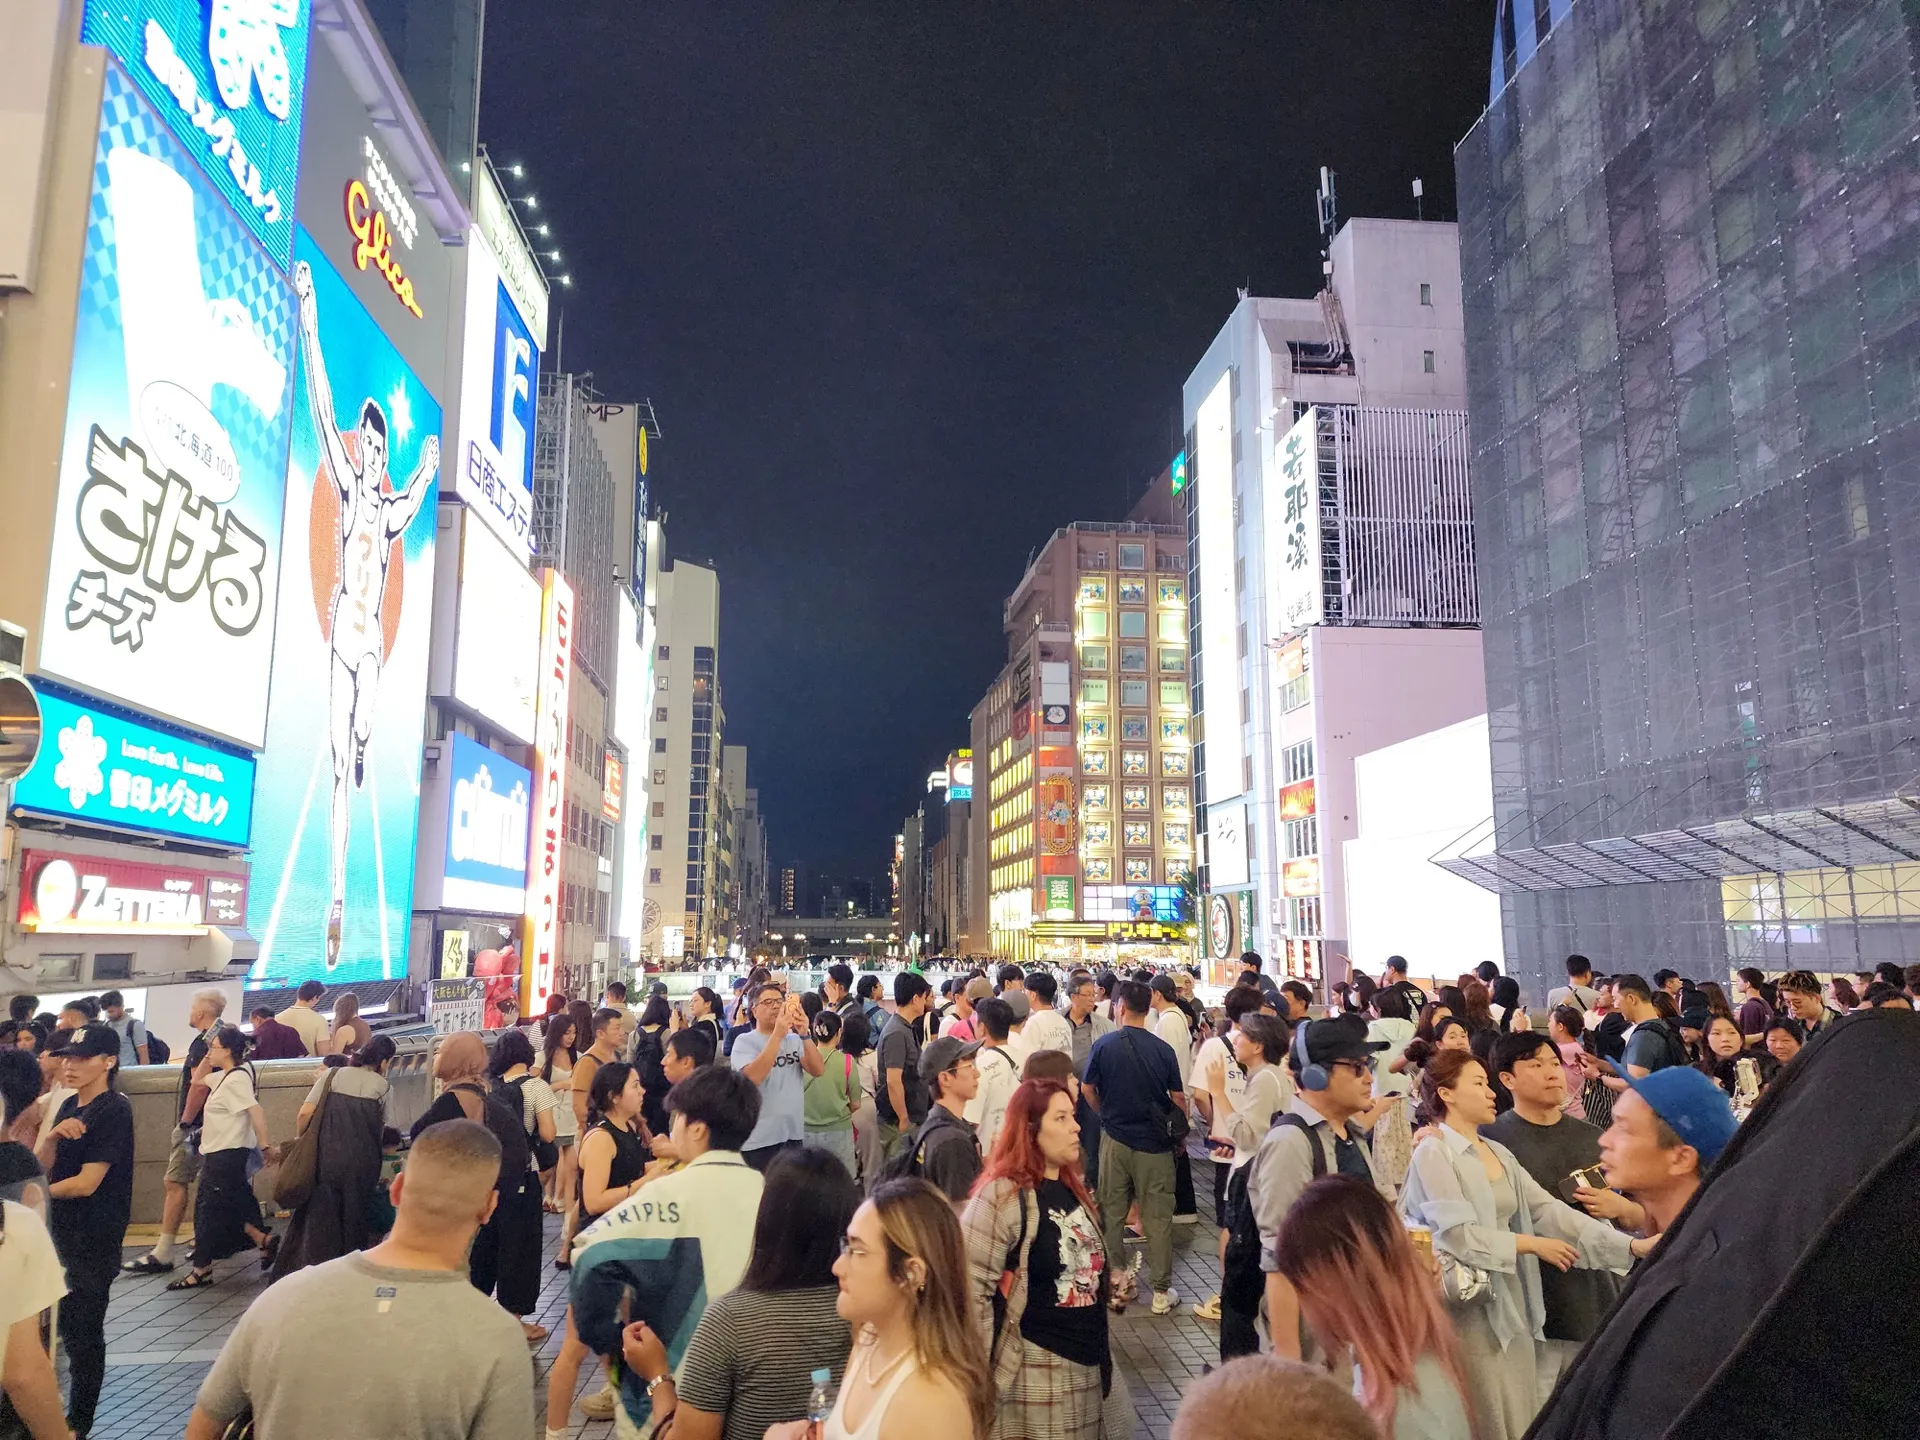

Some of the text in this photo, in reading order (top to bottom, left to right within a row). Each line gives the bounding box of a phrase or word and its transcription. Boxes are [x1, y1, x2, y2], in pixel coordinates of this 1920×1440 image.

[346, 179, 424, 320] Glico
[76, 422, 267, 637] さける
[65, 568, 157, 654] チーズ
[1050, 880, 1069, 899] 薬
[587, 1201, 681, 1235] STRIPES
